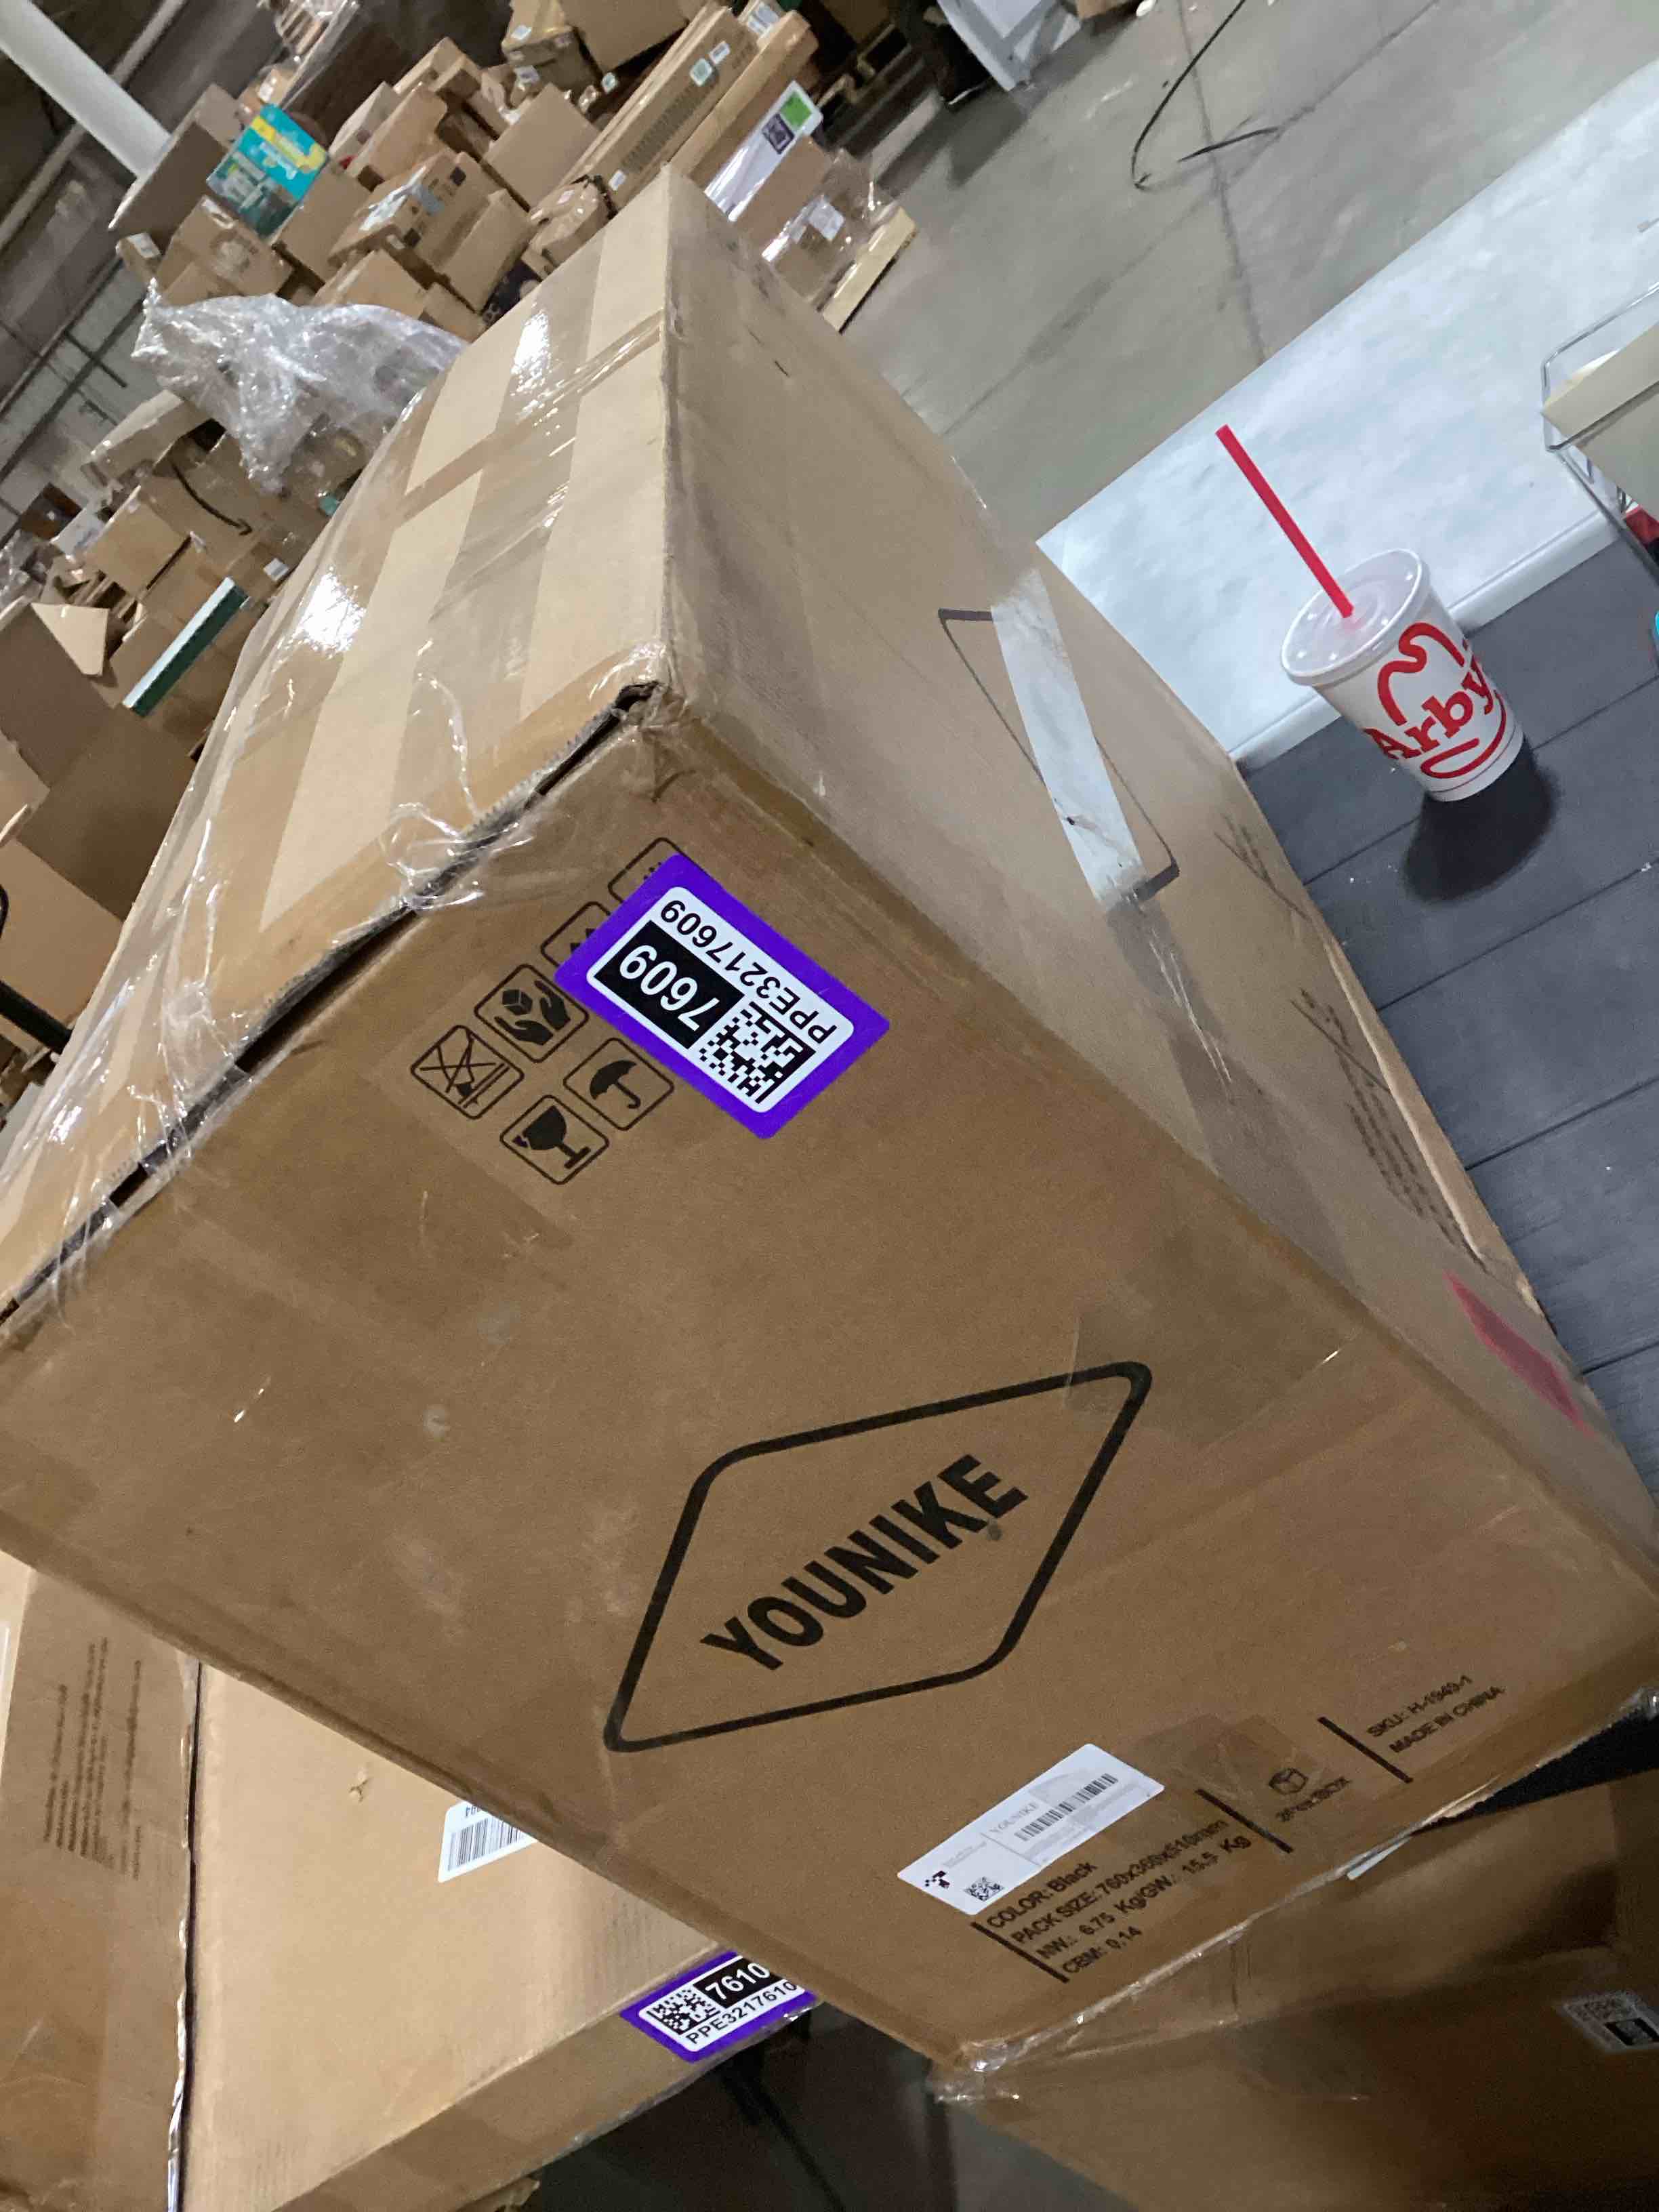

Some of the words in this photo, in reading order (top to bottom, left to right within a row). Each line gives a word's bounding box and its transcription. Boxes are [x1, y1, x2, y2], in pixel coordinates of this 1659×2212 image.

[619, 945, 720, 1031] 7609
[661, 900, 837, 1044] PPE3217609
[700, 1454, 1029, 1671] YOUNIKE
[1046, 1862, 1098, 1892] Black
[1011, 1913, 1063, 1944] PACK
[705, 1963, 771, 1999] 7610
[685, 1982, 798, 2044] PPE3217610
